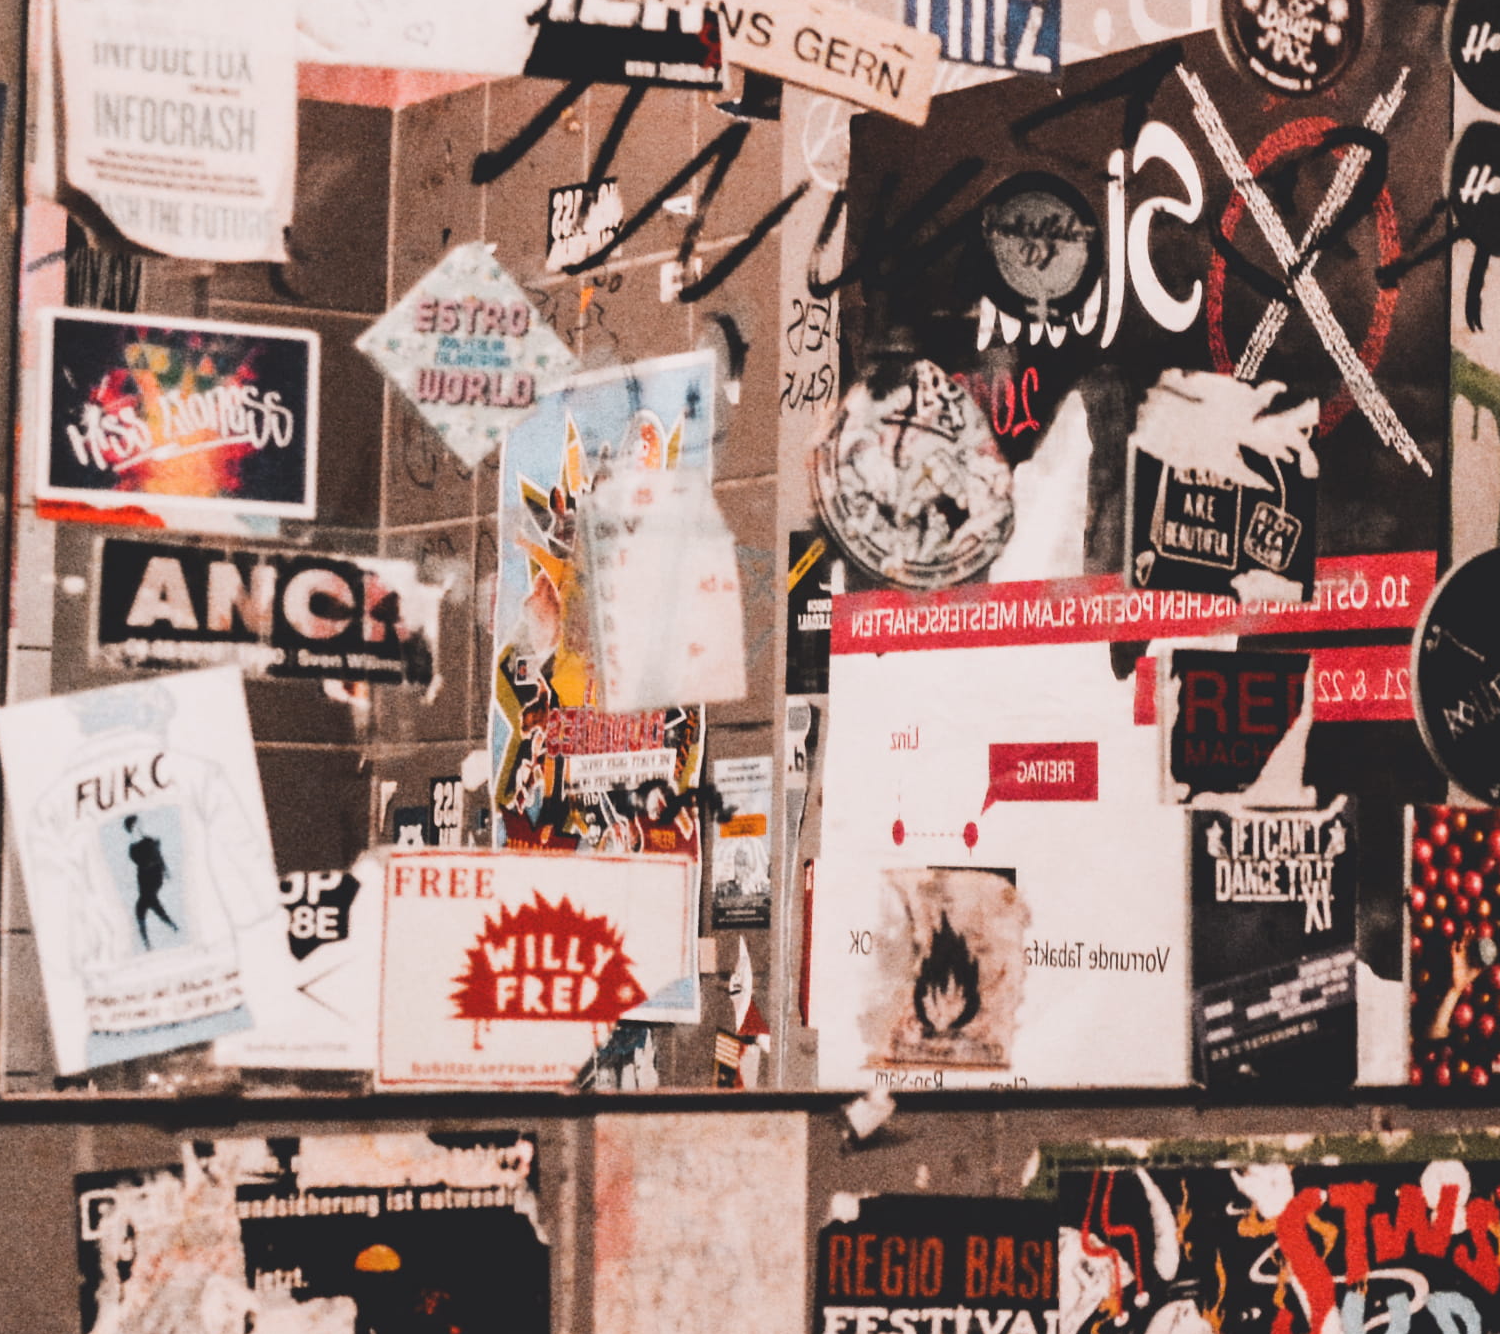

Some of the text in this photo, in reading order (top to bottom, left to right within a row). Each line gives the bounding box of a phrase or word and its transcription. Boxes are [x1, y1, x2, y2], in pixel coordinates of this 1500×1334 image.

[794, 28, 904, 98] GERN
[94, 91, 256, 154] INFOCRASH
[415, 369, 534, 408] WORLD
[1183, 492, 1216, 522] ARE
[394, 867, 495, 899] FREE
[1215, 859, 1281, 901] DANCE
[484, 934, 614, 973] WILLY
[829, 1235, 944, 1298] REGIO
